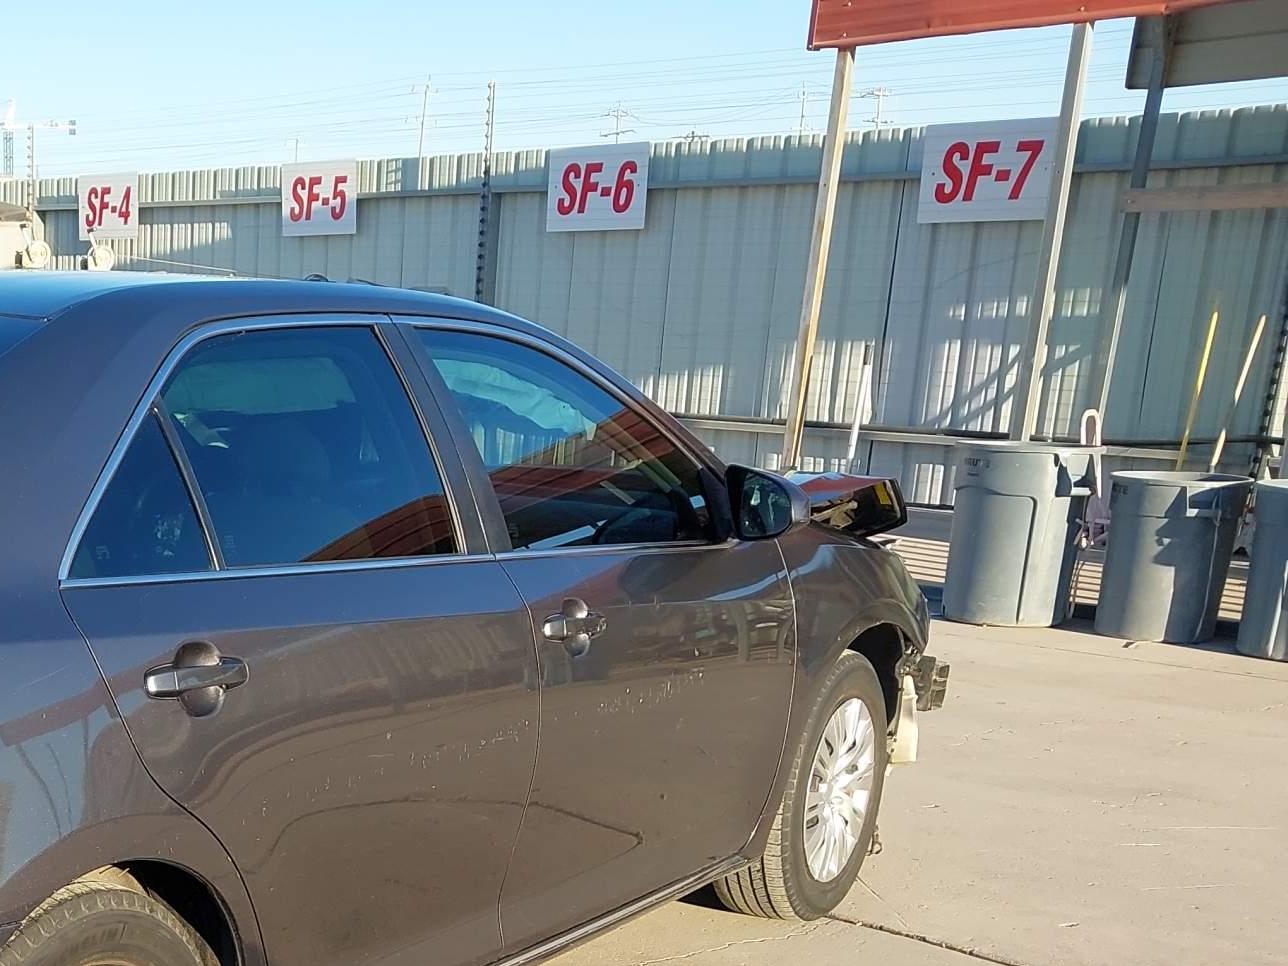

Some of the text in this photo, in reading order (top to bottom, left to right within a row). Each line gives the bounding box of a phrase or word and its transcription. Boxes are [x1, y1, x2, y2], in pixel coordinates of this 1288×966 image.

[557, 161, 637, 215] SF-6
[935, 140, 1044, 204] SF-7
[85, 186, 131, 227] SF-4
[290, 175, 347, 222] SF-5
